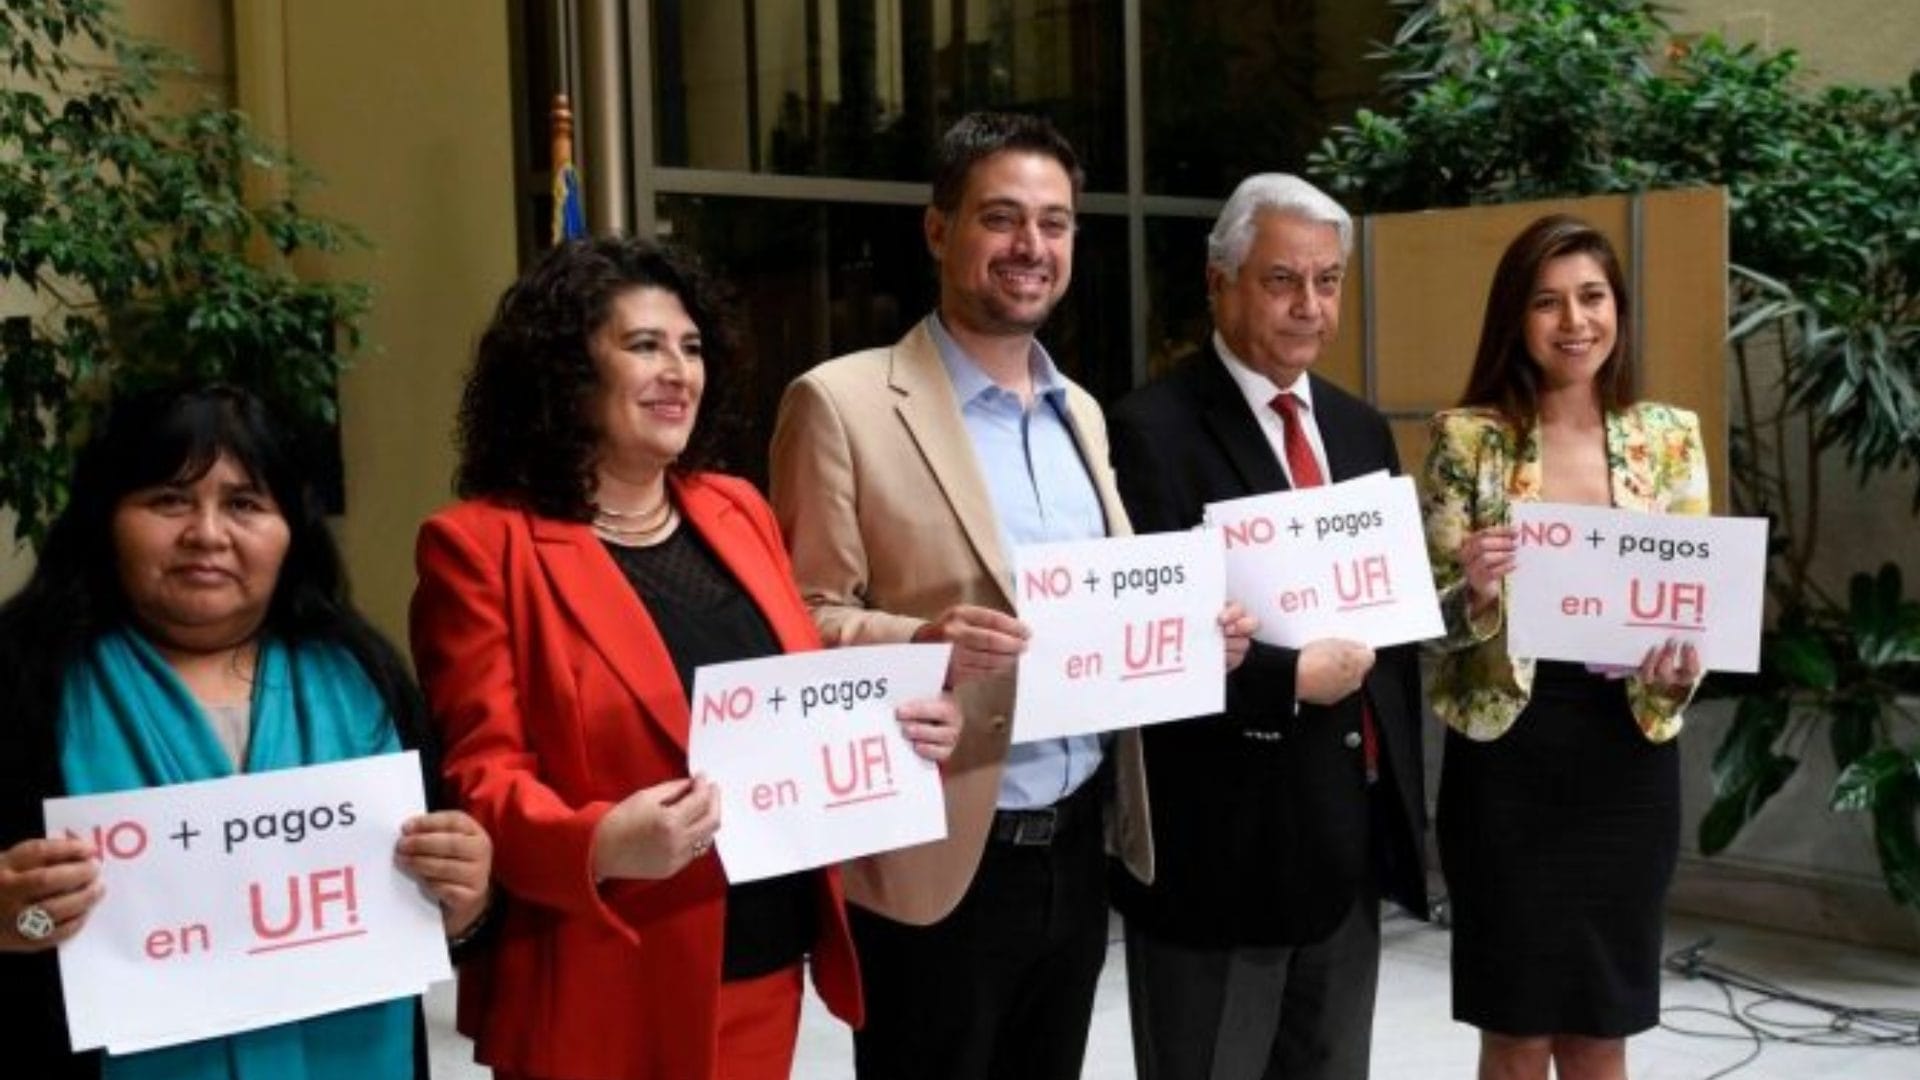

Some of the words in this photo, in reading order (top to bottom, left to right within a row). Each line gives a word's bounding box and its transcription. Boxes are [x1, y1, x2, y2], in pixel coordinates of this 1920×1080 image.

[1222, 517, 1276, 550] NO
[1287, 517, 1305, 538] +
[1315, 510, 1384, 541] pagos
[1520, 521, 1573, 548] NO
[1585, 528, 1606, 549] +
[1618, 533, 1710, 561] pagos
[1024, 566, 1072, 600] NO
[1083, 570, 1101, 593] +
[1112, 564, 1186, 599] pagos
[1279, 587, 1319, 613] en
[1560, 595, 1603, 616] en
[1629, 578, 1706, 623] UF!
[1065, 651, 1103, 680] en
[1124, 617, 1185, 670] UF!
[701, 685, 755, 725] NO
[766, 686, 788, 713] +
[800, 677, 889, 717] pagos
[751, 778, 799, 812] en
[821, 735, 894, 797] UF!
[169, 820, 201, 850] +
[223, 801, 357, 854] pagos
[144, 923, 211, 960] en
[248, 866, 358, 940] UF!
